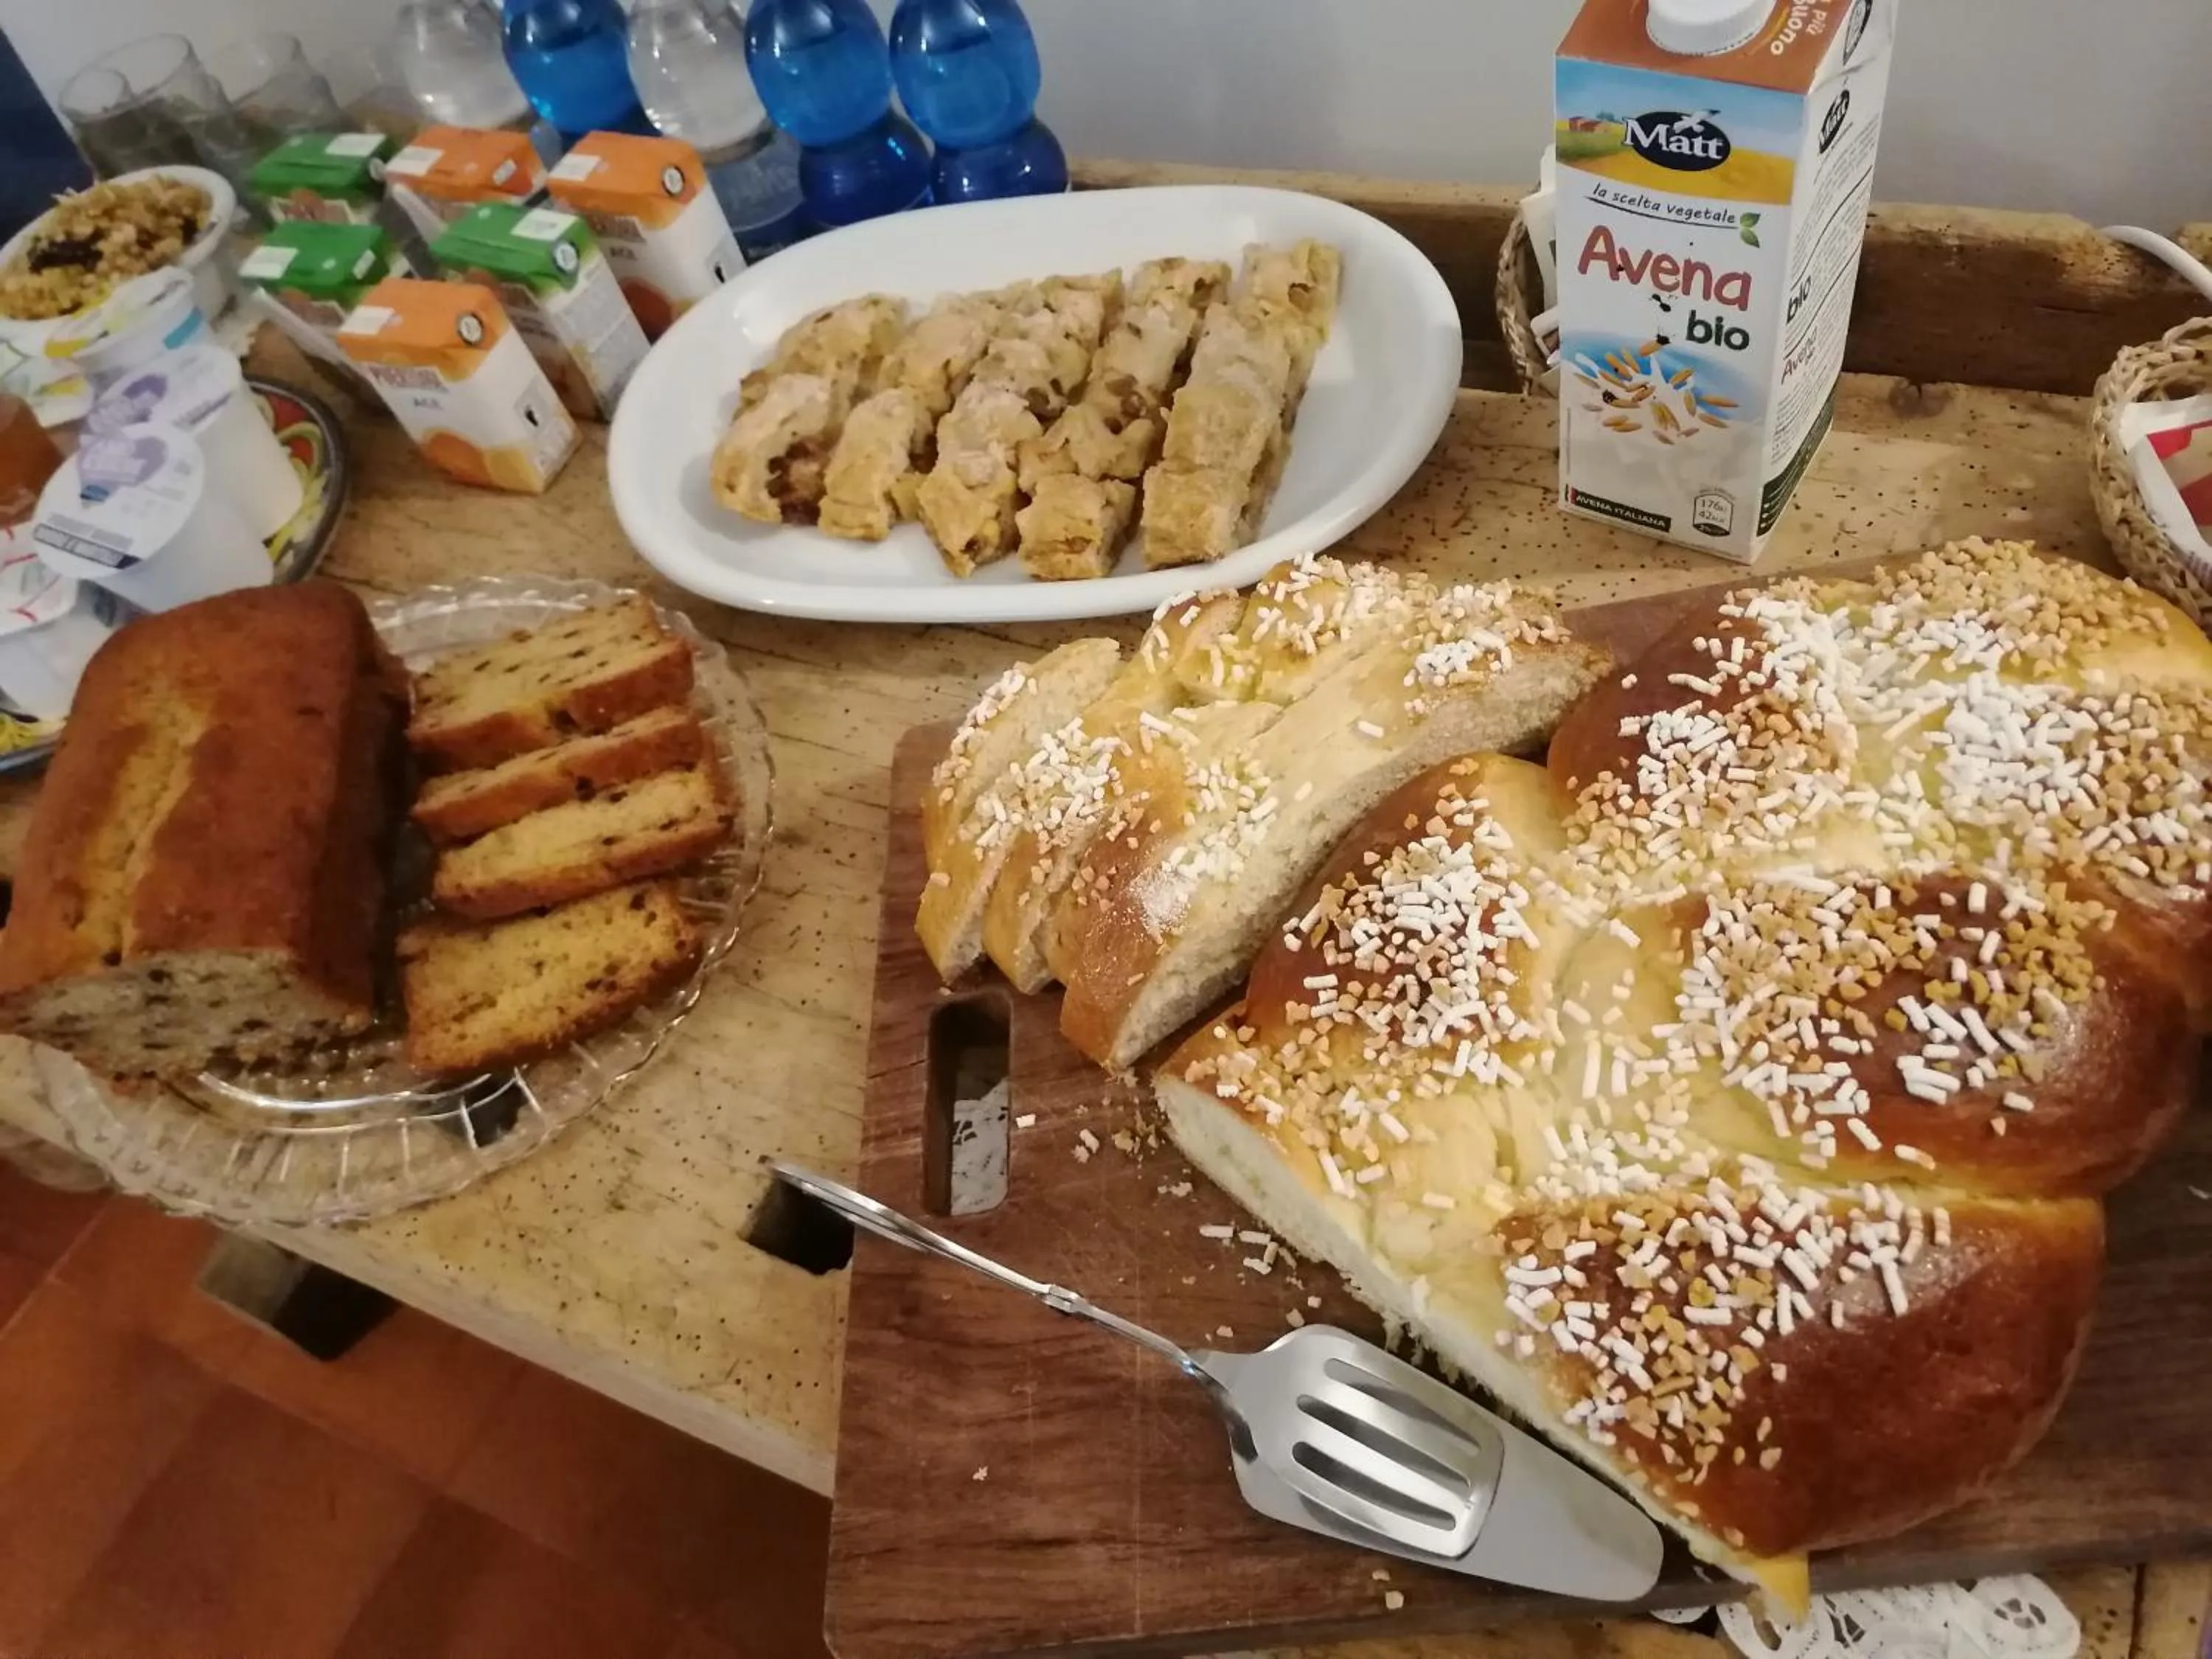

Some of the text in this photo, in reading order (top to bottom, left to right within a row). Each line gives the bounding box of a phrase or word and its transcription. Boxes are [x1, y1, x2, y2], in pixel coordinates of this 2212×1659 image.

[1624, 119, 1723, 160] Matt
[1593, 182, 1736, 223] la scelta vegetale
[1577, 225, 1752, 311] Avena
[1686, 309, 1750, 351] bio
[1576, 495, 1666, 527] AVENA ITALIANA
